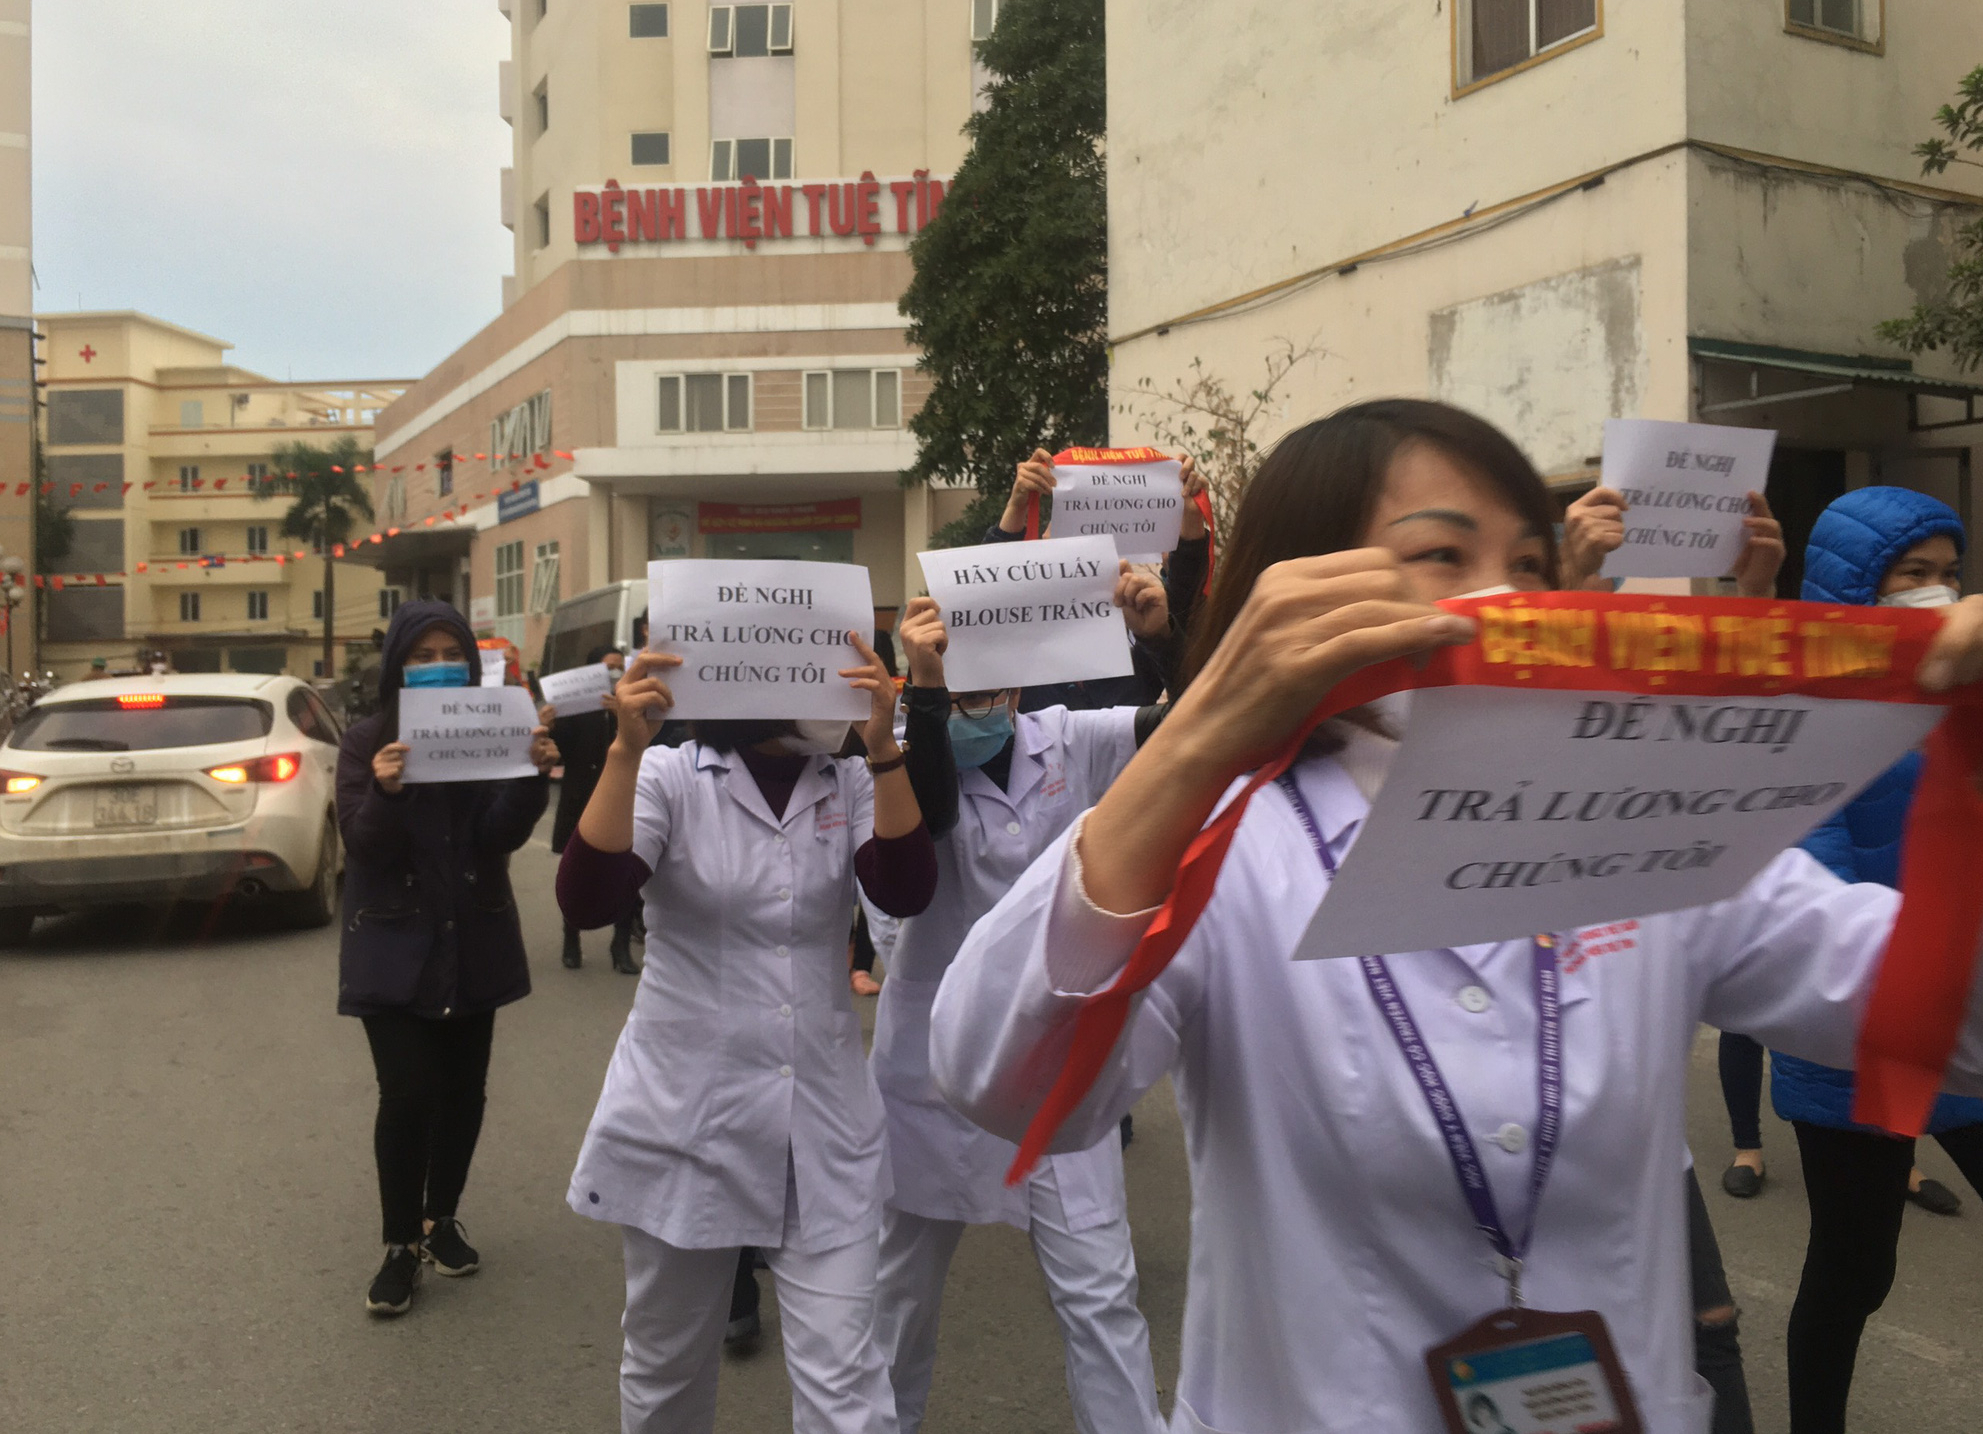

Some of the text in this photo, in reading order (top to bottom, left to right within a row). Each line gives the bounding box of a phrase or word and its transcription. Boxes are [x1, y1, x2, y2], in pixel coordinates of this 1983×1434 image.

[574, 178, 686, 252] BỆNH
[698, 174, 792, 250] VIỆN
[802, 171, 881, 246] TUỆ
[1071, 447, 1098, 463] BỆNH
[1100, 450, 1125, 462] VIỆN
[1125, 447, 1147, 461] TUỆ
[1693, 454, 1736, 477] NGHỊ
[1092, 472, 1147, 487] ĐỀ NGHỊ
[1063, 497, 1176, 511] TRẢ LƯƠNG CHO
[1716, 496, 1753, 514] CHO
[1080, 519, 1156, 535] CHÚNG TÔI
[1624, 524, 1719, 549] CHÚNG TÔI
[954, 557, 1101, 585] HÃY CỨU LẤY
[717, 582, 814, 610] ĐỀ NGHỊ
[951, 599, 1110, 628] BLOUSE TRẮNG
[667, 621, 714, 642] TRẢ
[723, 625, 804, 645] LƯƠNG
[1477, 597, 1596, 680] BỆNH
[1603, 602, 1704, 686] VIỆN
[699, 661, 826, 684] CHÚNG TÔI
[500, 727, 531, 738] CHO
[1568, 696, 1813, 754] ĐỀ NGHỊ
[1414, 780, 1847, 821] TRẢ LƯƠNG CHO
[1445, 840, 1727, 890] CHÚNG TÔI
